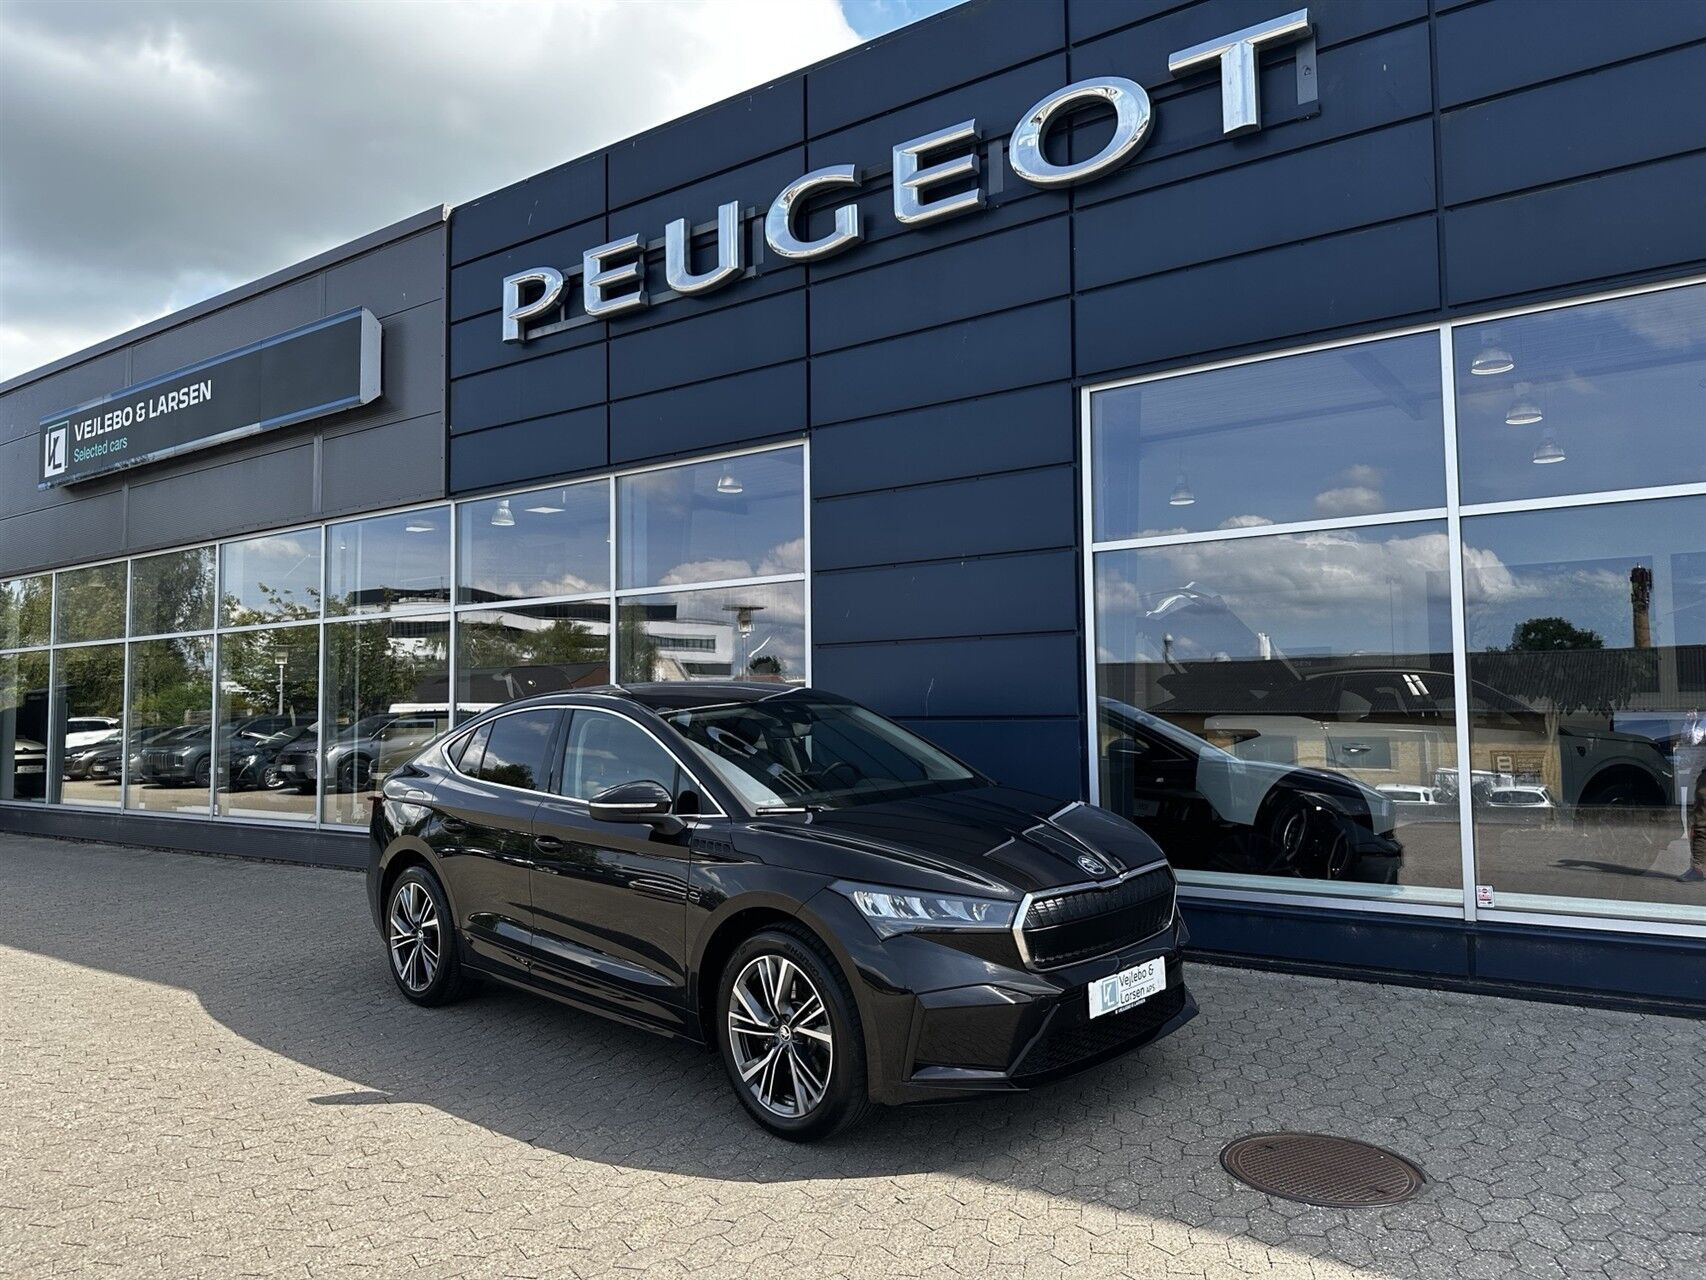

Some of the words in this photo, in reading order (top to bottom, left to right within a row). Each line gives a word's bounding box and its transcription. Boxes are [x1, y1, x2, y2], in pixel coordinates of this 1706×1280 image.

[502, 8, 1312, 344] PEUGEOT
[74, 406, 133, 441] VEJLEBO
[136, 402, 146, 422] &
[149, 380, 212, 418] LARSEN
[73, 440, 107, 463] Selected
[109, 437, 128, 451] cars
[1119, 969, 1147, 987] Vejlebo
[1148, 964, 1154, 976] &
[1120, 987, 1145, 1004] Larsen
